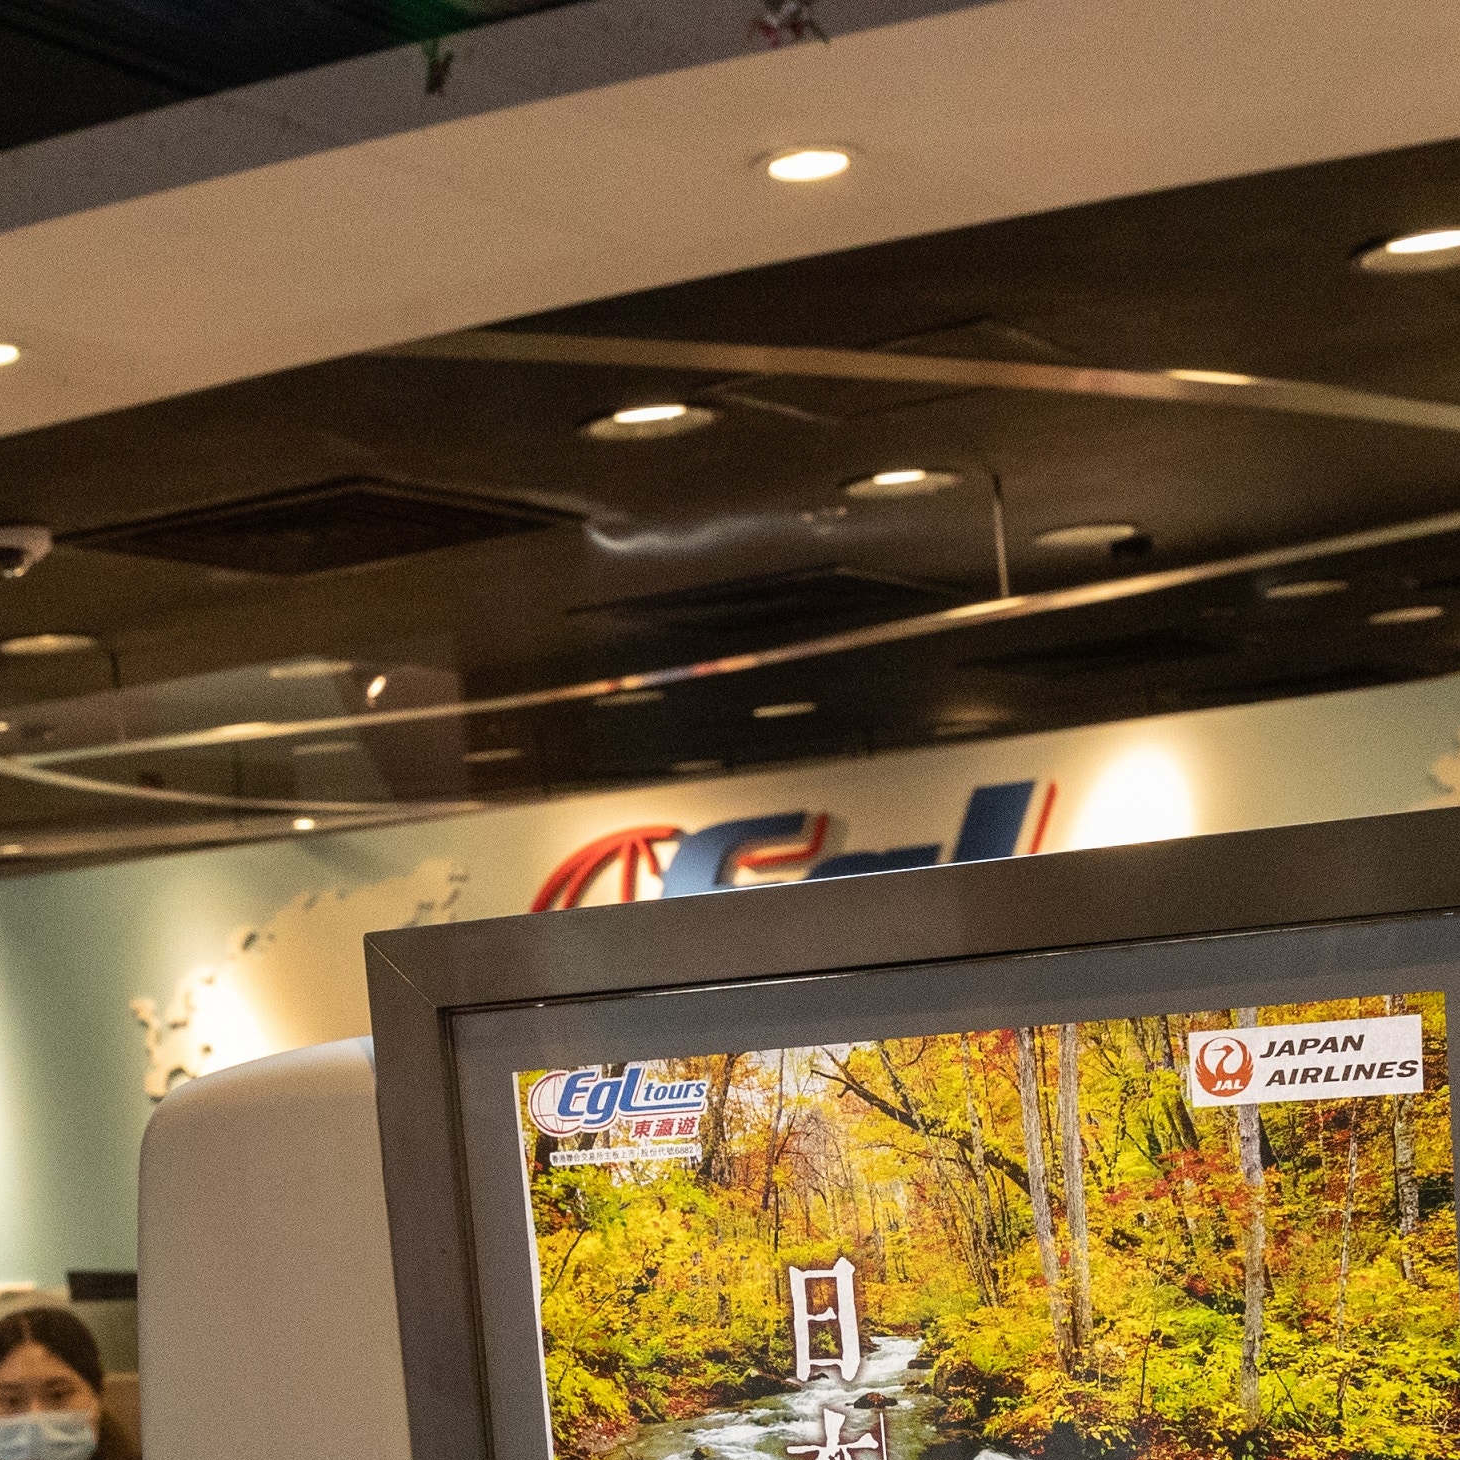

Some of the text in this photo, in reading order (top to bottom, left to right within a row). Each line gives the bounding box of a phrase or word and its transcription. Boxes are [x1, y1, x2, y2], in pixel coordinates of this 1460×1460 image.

[1260, 1034, 1365, 1058] JAPAN
[1265, 1060, 1418, 1086] AIRLINES
[644, 1080, 707, 1100] tours
[1211, 1080, 1245, 1092] JAL
[632, 1117, 698, 1138] 東瀛遊
